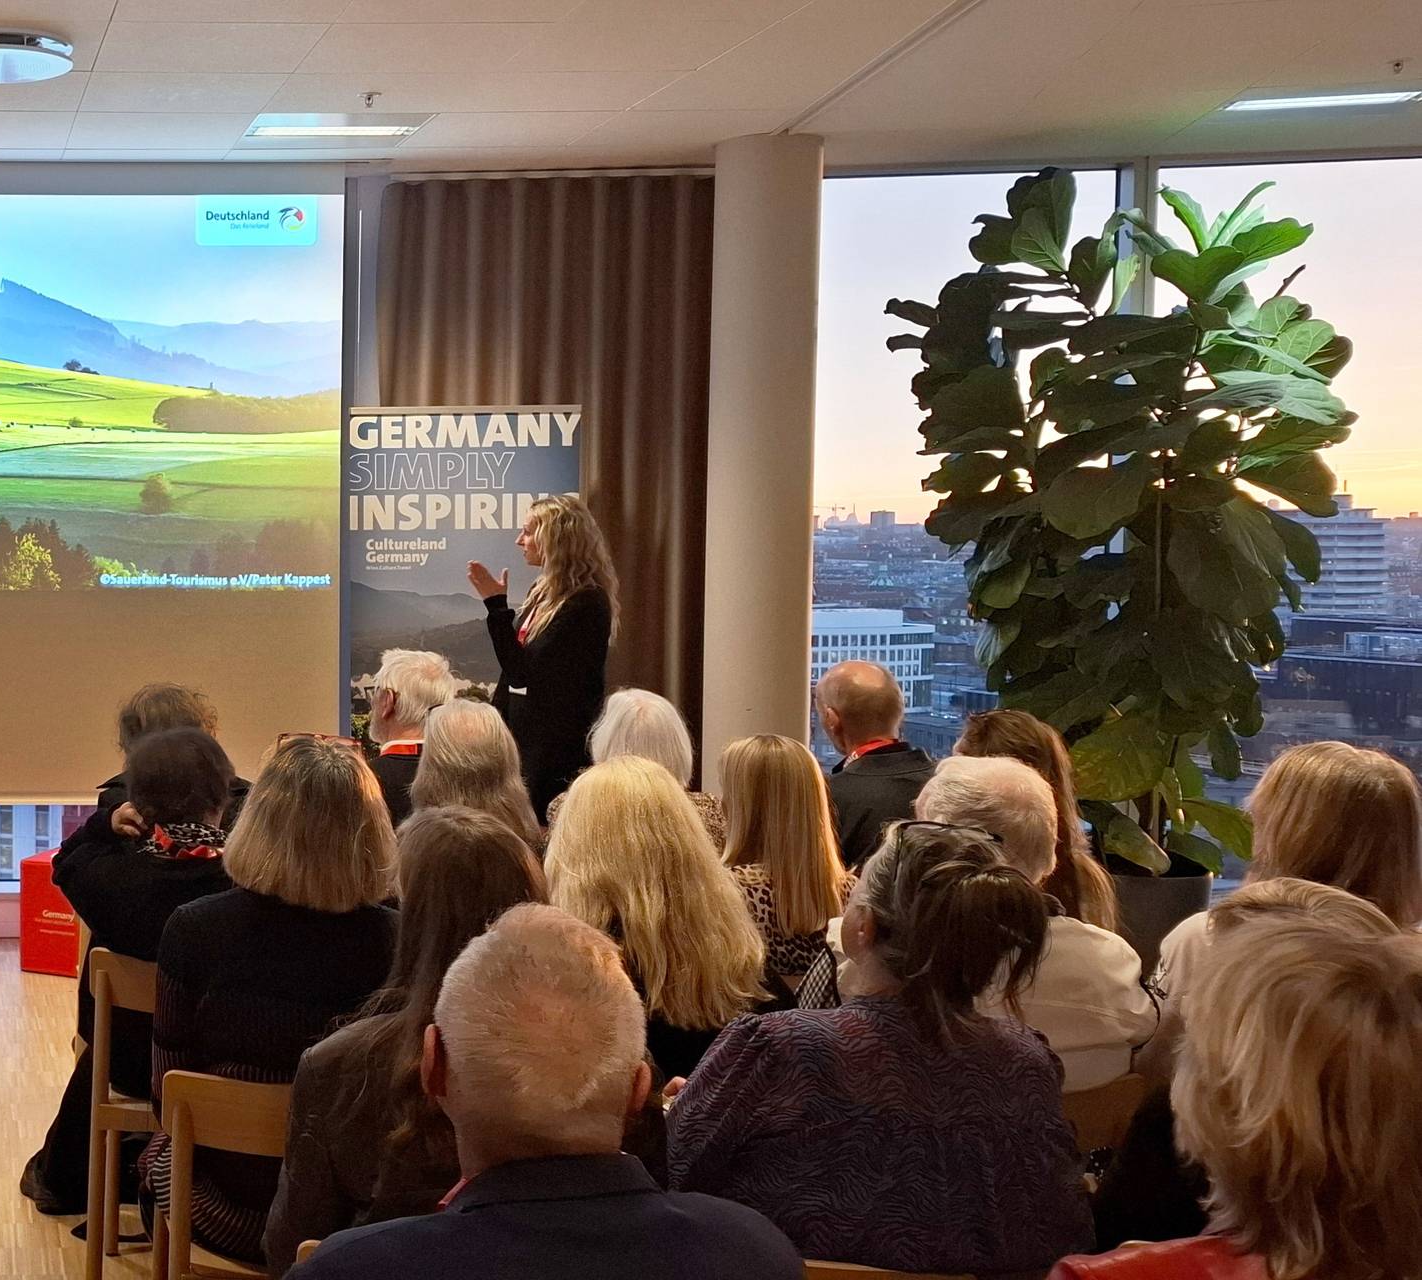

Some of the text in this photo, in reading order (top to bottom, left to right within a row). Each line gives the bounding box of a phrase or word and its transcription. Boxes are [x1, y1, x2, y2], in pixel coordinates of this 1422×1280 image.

[205, 210, 270, 221] Deutschland
[349, 412, 582, 449] GERMANY
[349, 451, 516, 491] SIMPLY
[366, 537, 447, 551] Cultureland
[365, 550, 430, 566] Germany
[284, 573, 331, 587] Kappest
[42, 909, 76, 923] Germany
